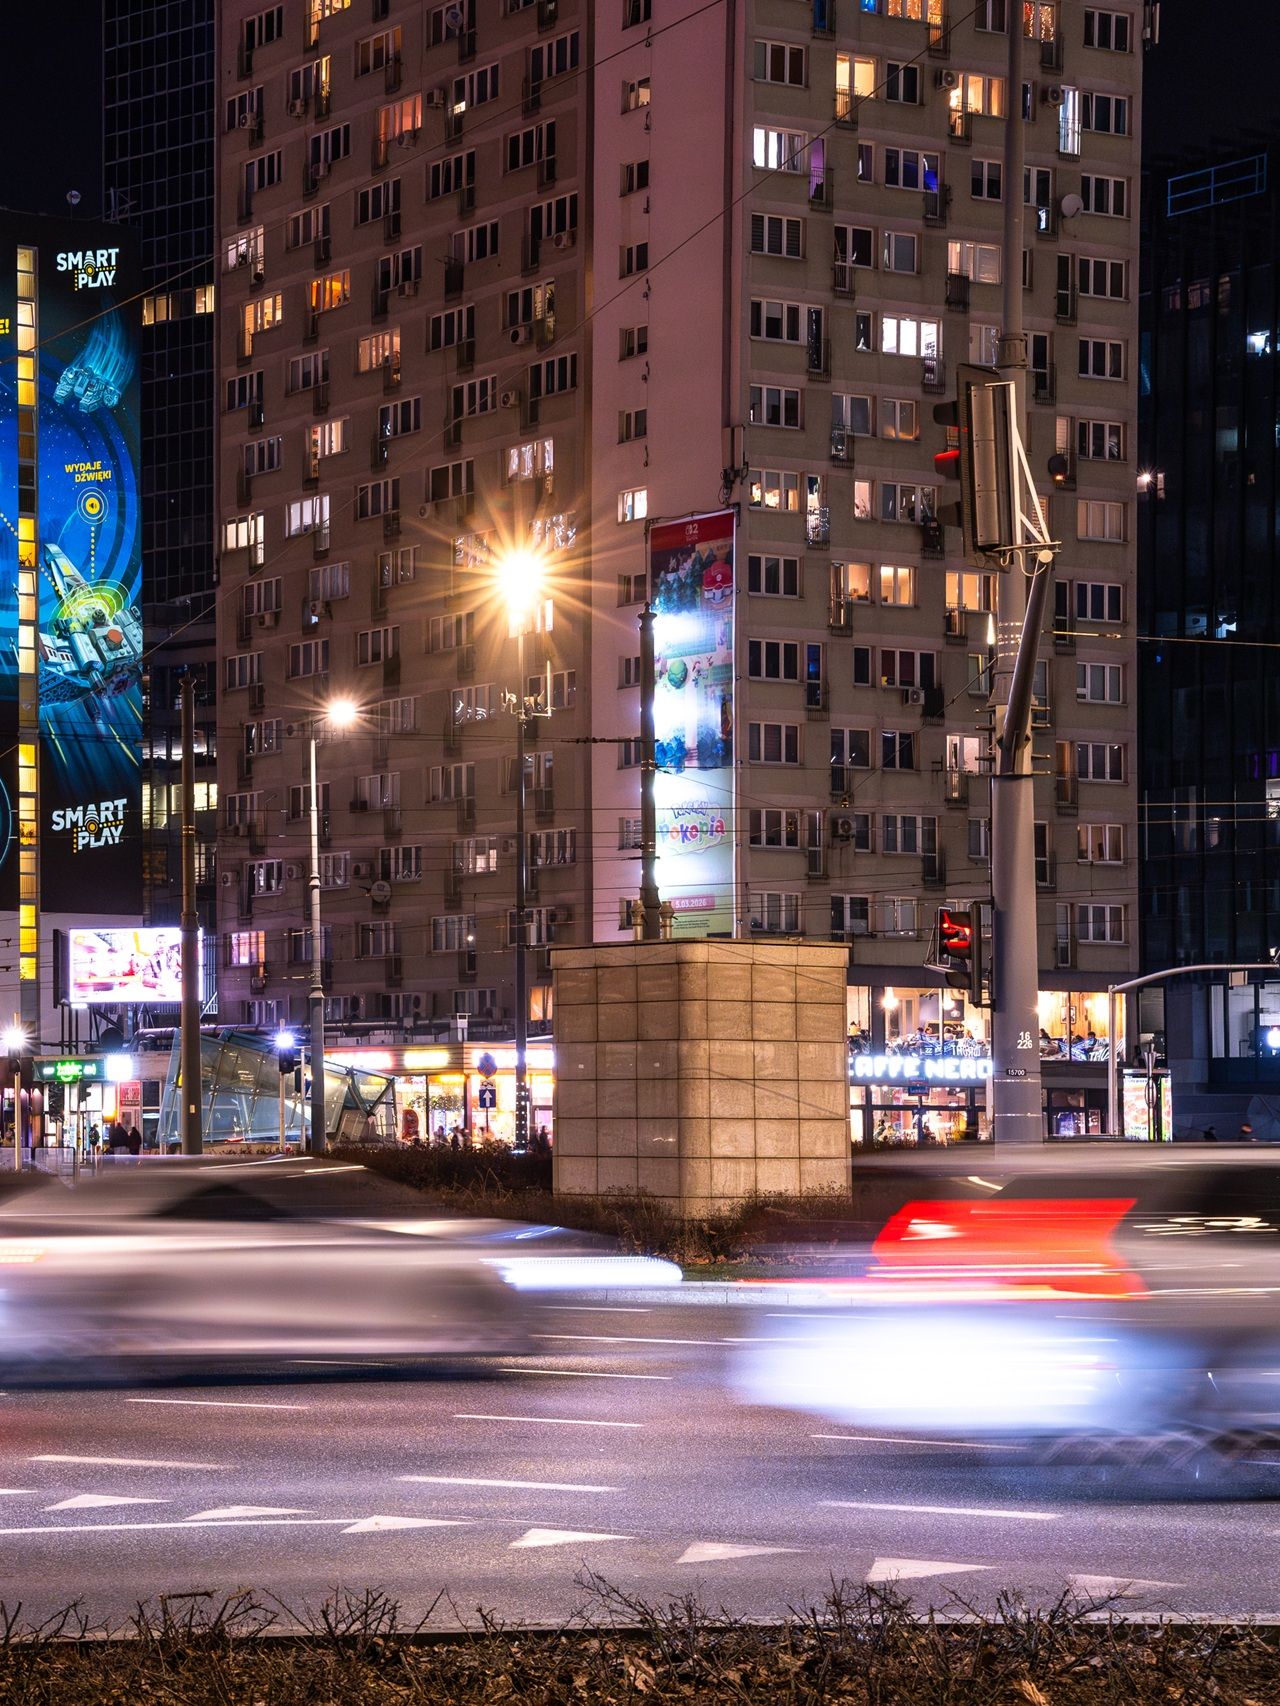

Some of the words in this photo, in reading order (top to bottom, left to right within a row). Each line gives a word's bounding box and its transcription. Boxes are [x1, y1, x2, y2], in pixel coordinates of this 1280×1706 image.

[56, 248, 120, 272] SMART
[78, 269, 116, 289] PLAY
[65, 461, 102, 474] WYDAJE
[74, 470, 112, 484] DŹWIĘKI
[51, 798, 127, 831] SMART
[78, 824, 124, 851] PLAY
[1017, 1039, 1033, 1049] 226
[1019, 1031, 1031, 1041] 16
[924, 1057, 994, 1079] NERO
